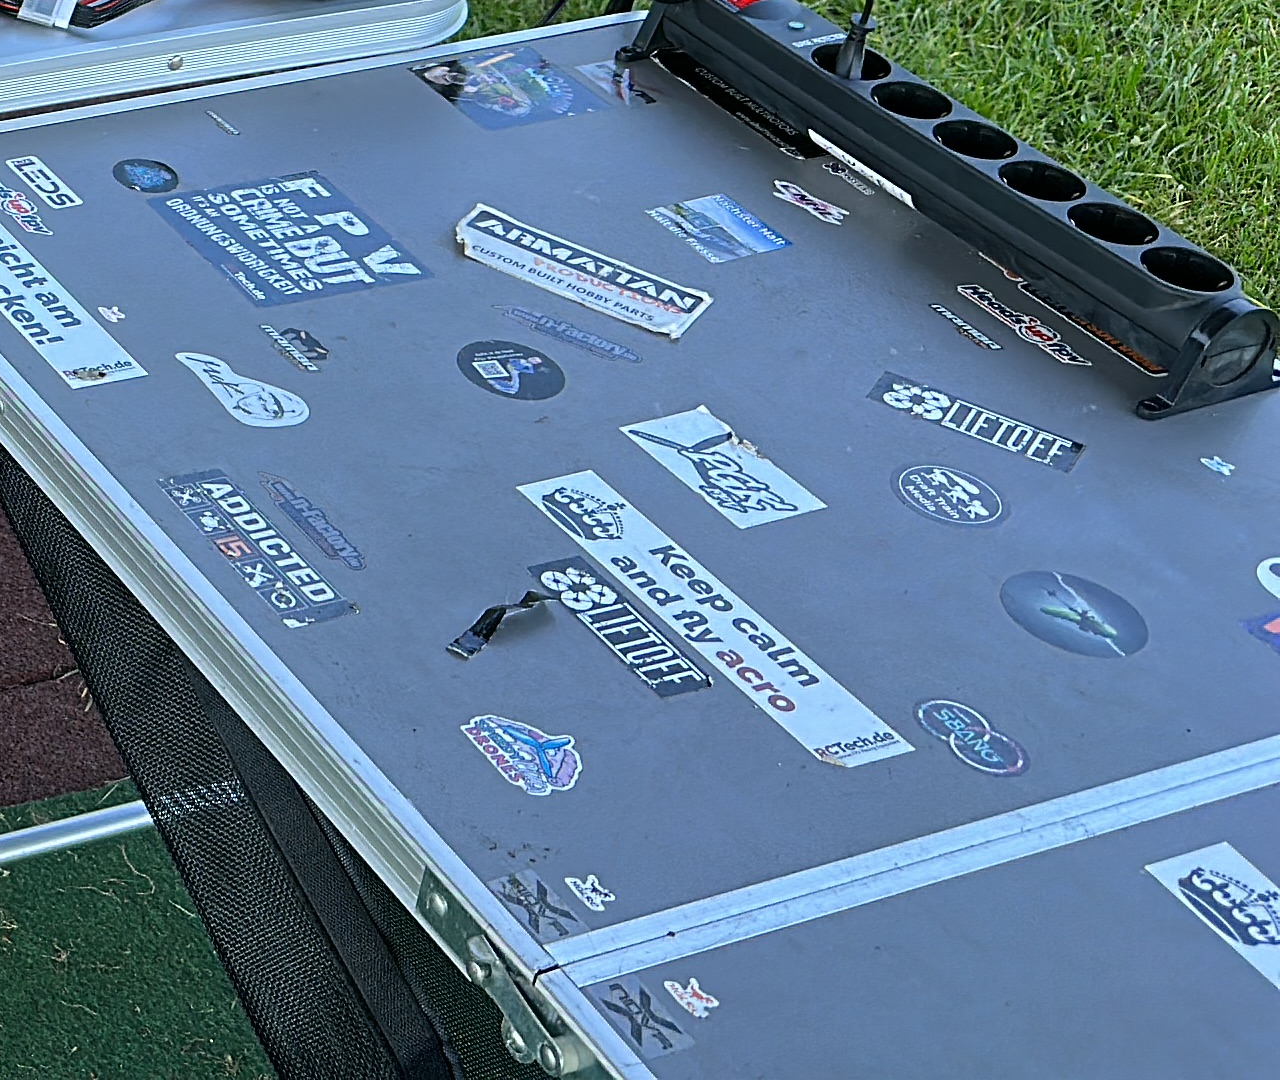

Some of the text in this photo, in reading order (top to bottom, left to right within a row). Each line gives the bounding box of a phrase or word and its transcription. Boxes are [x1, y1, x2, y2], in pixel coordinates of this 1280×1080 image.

[15, 160, 76, 206] LEDS
[204, 207, 220, 218] AN
[274, 199, 308, 220] NOT
[302, 224, 321, 234] A
[165, 198, 303, 296] ORDNUNGSWIDRIGKEIT
[207, 192, 324, 292] SOMETIMES
[231, 188, 376, 284] CRIME BUT
[475, 219, 698, 309] ARMATTAN
[35, 292, 83, 328] am
[472, 244, 527, 271] CUSTOM
[527, 265, 565, 286] BUILT
[566, 280, 613, 305] HOBBY
[612, 299, 654, 322] PARTS
[533, 255, 684, 315] PRODUCTIONS
[942, 402, 1072, 464] LIFTOFF
[905, 486, 936, 511] Media
[909, 475, 959, 519] Draft Train
[202, 483, 335, 603] ADDICTED
[582, 604, 702, 684] LIFTOFF
[611, 554, 797, 713] and fly acro
[648, 544, 820, 688] Keep calm
[813, 732, 894, 758] RCTech.de
